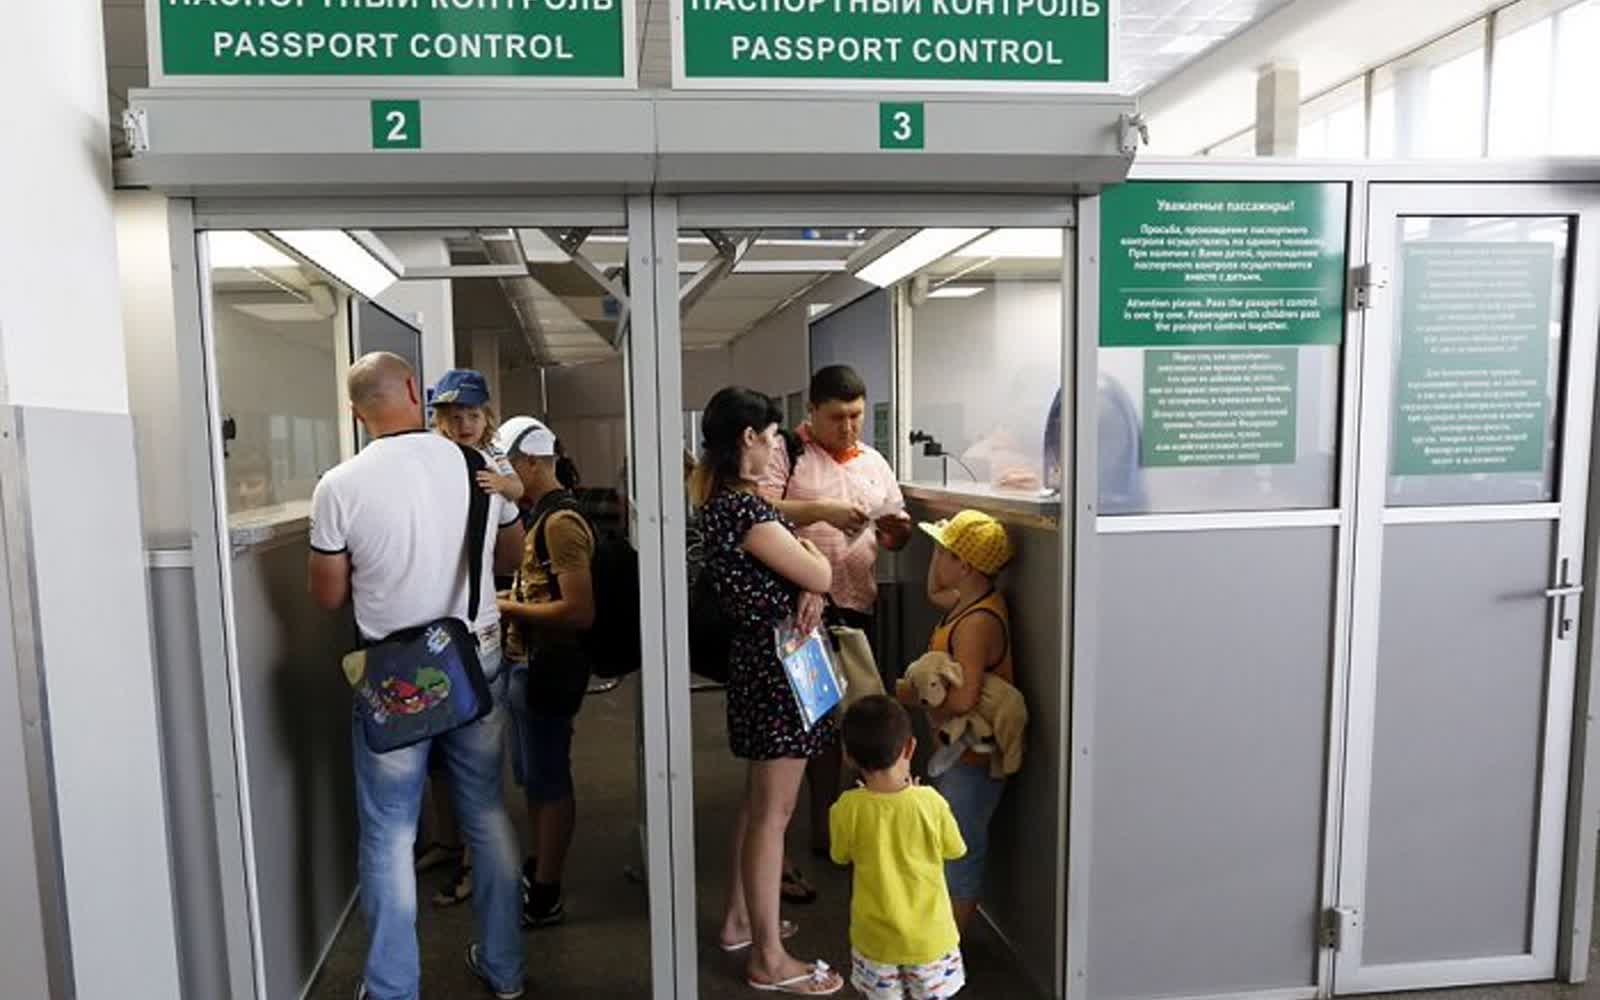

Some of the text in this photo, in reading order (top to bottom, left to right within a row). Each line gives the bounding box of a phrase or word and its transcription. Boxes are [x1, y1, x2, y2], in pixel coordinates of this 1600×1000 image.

[933, 0, 1101, 17] КОНТРОЛЬ
[214, 31, 574, 59] PASSPORT CONTROL
[731, 35, 1063, 65] PASSPORT CONTROL
[385, 111, 408, 141] 2
[892, 112, 912, 141] 3
